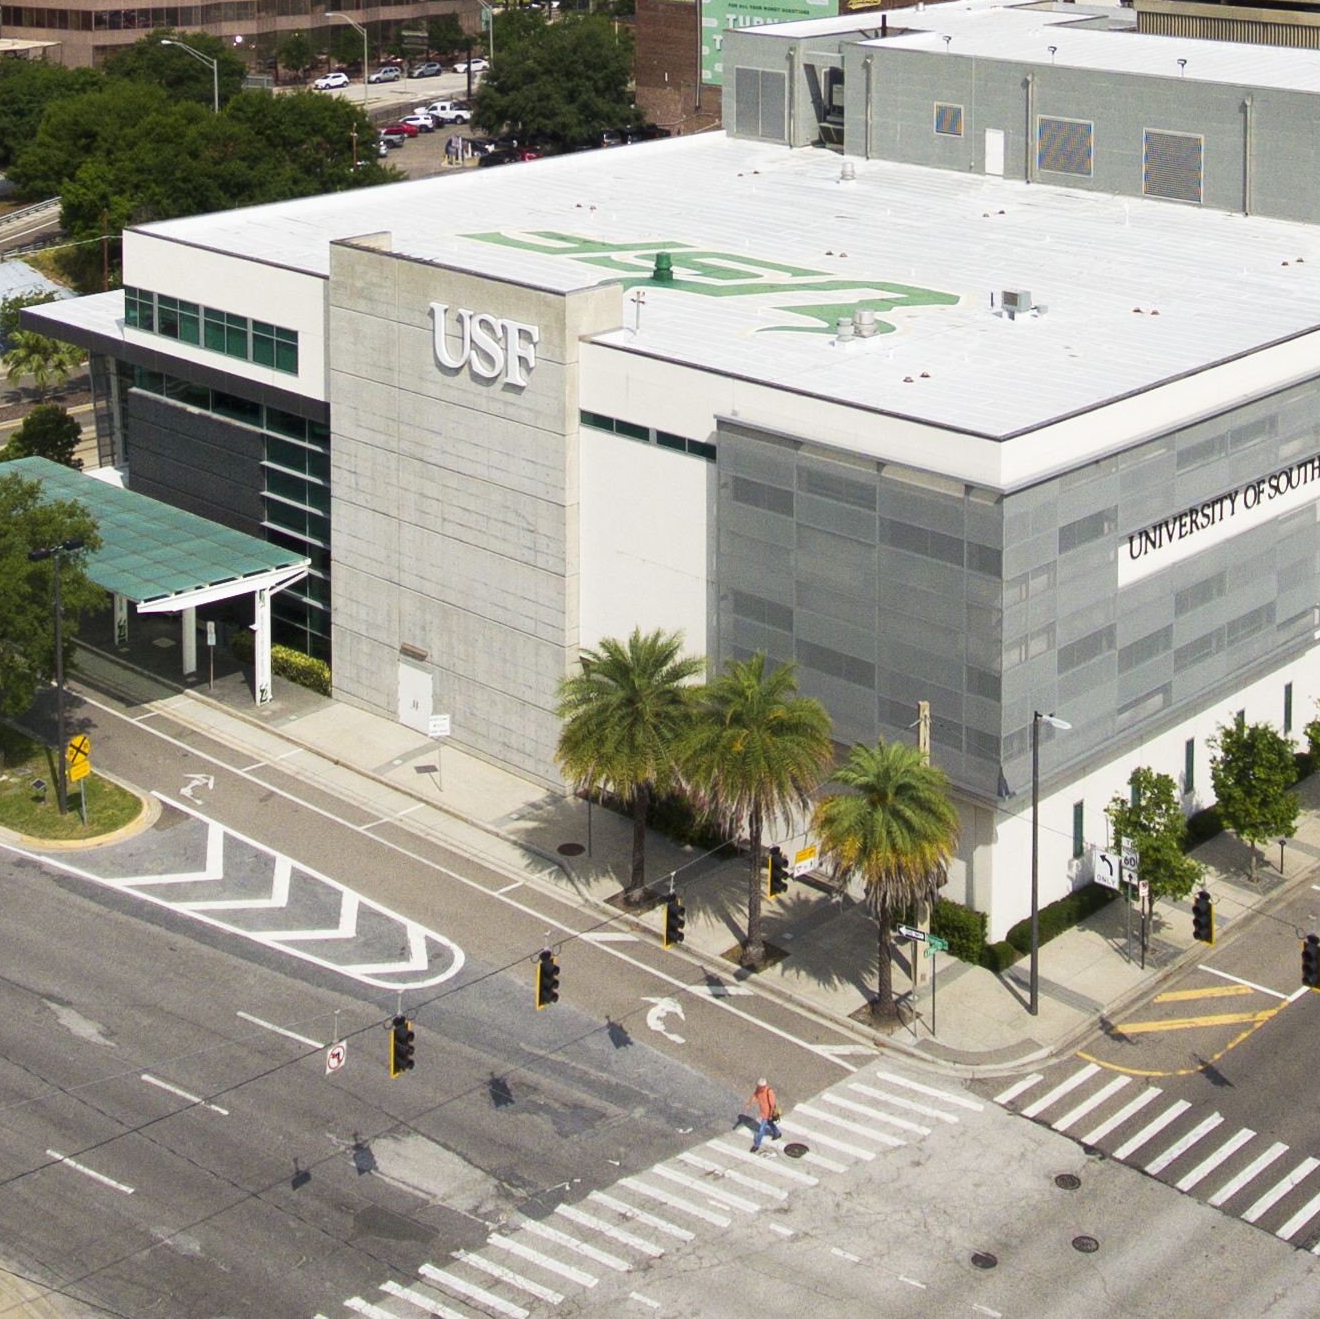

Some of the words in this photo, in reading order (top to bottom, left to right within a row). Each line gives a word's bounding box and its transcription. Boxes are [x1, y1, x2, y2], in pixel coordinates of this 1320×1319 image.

[429, 301, 539, 386] USF
[1128, 490, 1239, 560] UNIVERSITY
[1243, 479, 1266, 510] OF
[1096, 873, 1116, 886] ONLY
[1123, 855, 1136, 868] 60
